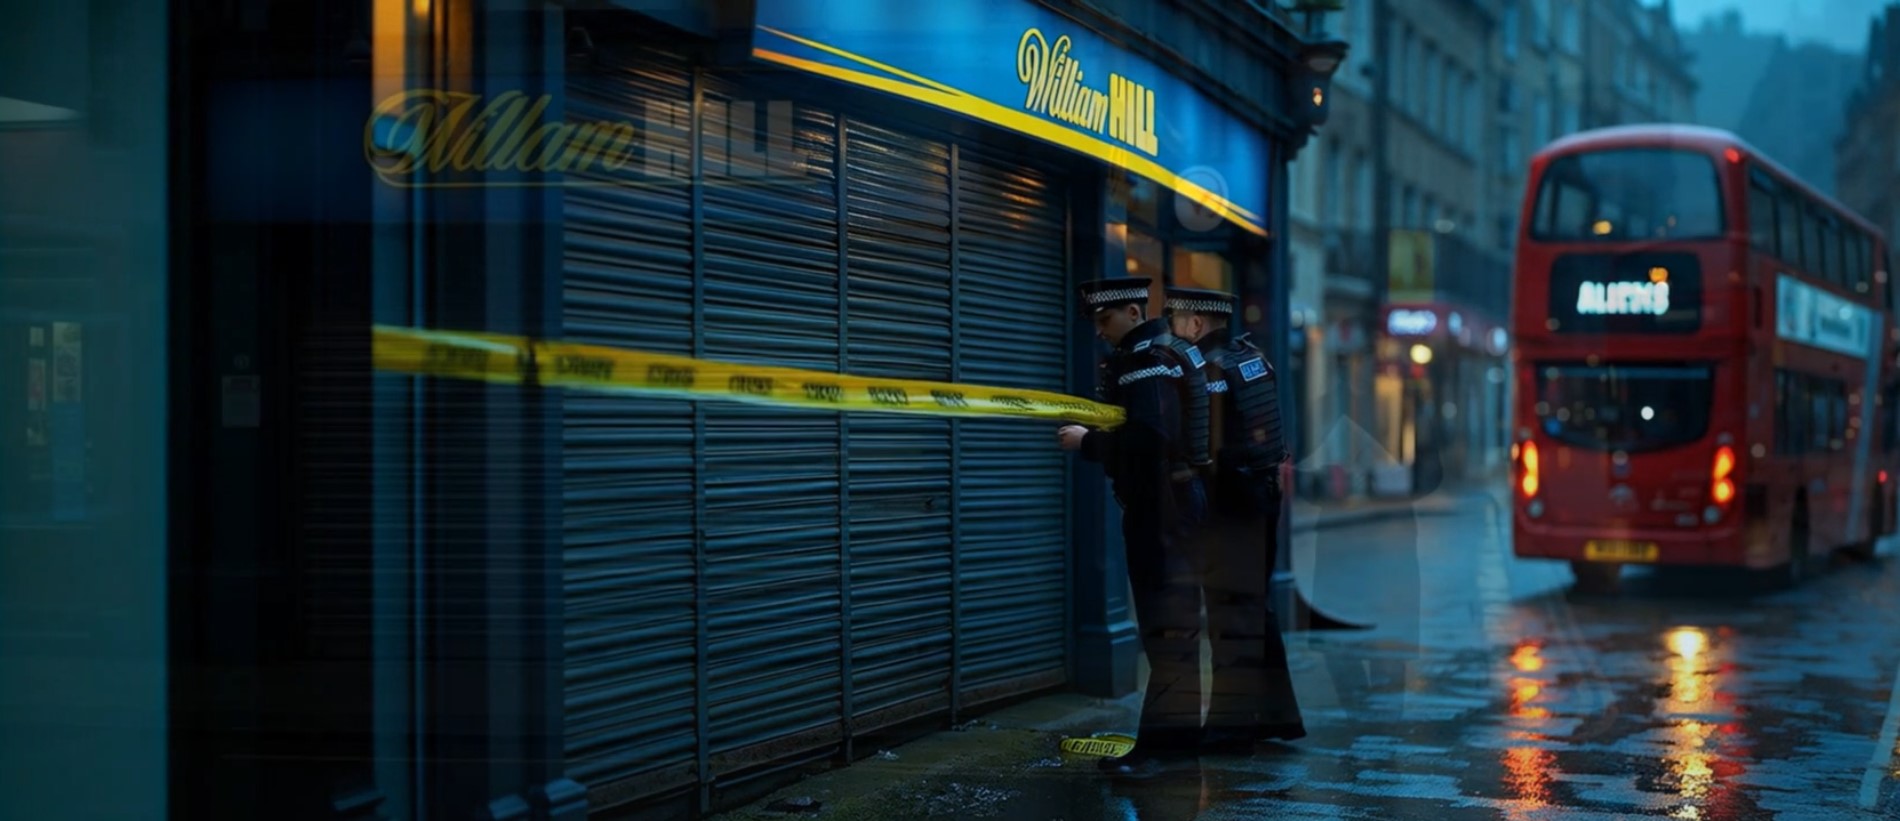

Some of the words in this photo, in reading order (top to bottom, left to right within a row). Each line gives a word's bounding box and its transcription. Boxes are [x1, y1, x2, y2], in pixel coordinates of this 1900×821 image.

[644, 100, 808, 176] HILL
[1017, 27, 1108, 134] William
[1109, 73, 1158, 157] HILL
